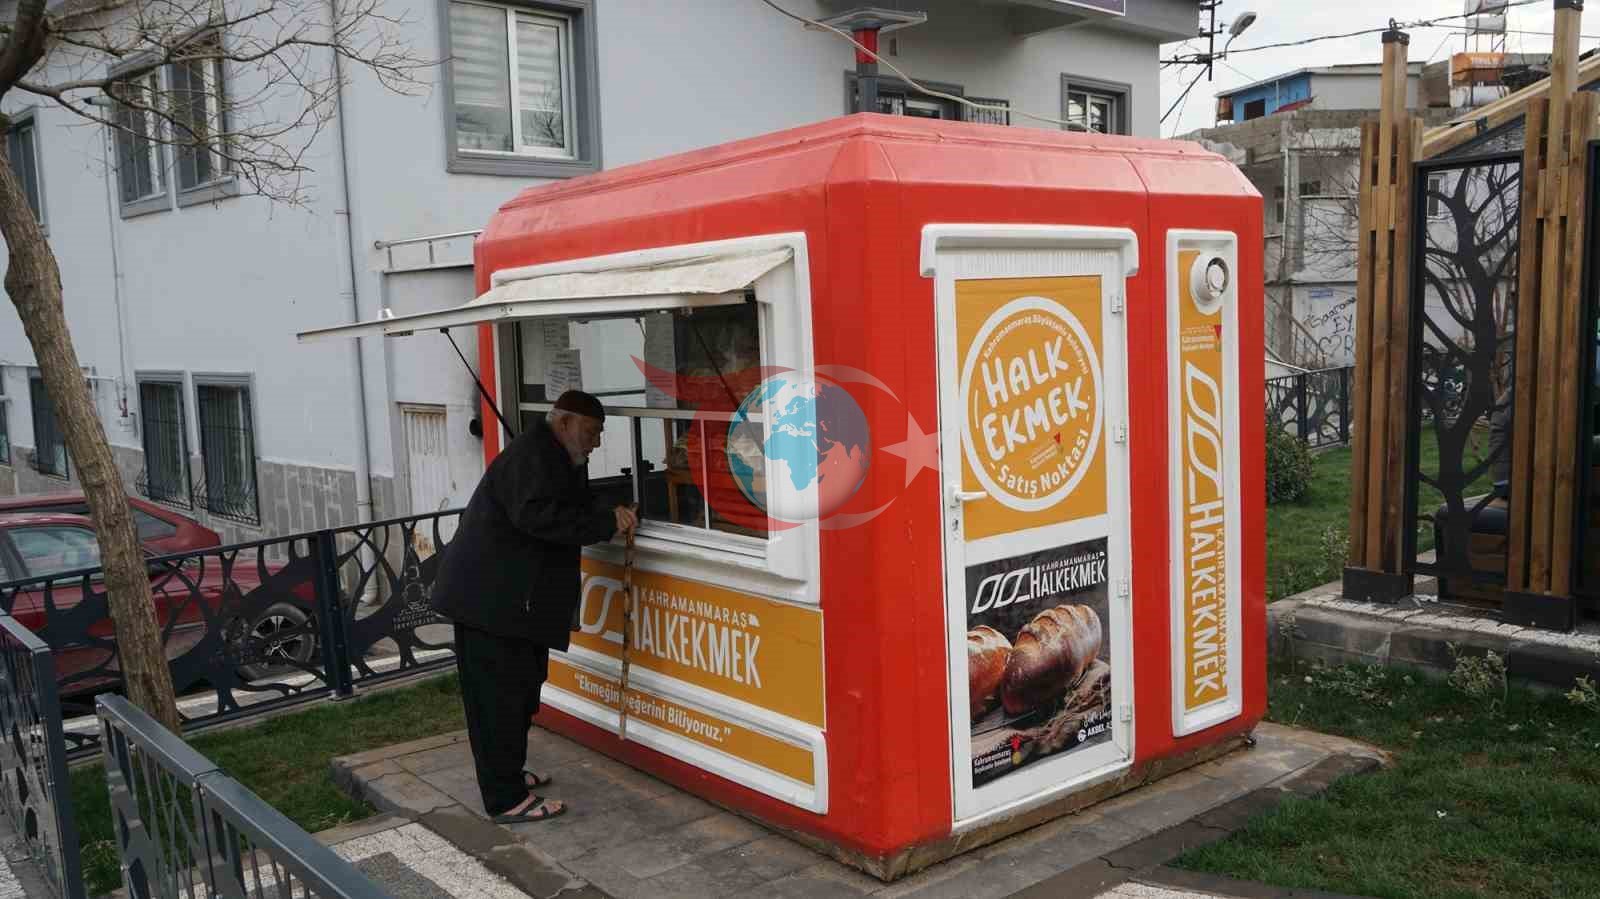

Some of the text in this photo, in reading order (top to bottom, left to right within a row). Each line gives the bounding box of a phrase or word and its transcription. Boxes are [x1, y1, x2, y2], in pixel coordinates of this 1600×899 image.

[981, 335, 1069, 408] HALK
[982, 376, 1089, 462] EKMEK
[998, 464, 1039, 499] Satış
[1040, 429, 1089, 492] Noktası
[640, 586, 748, 628] KAHRAMANMARAŞ
[1030, 558, 1107, 600] HALKEKMEK
[1189, 499, 1224, 698] HALKEKMEK
